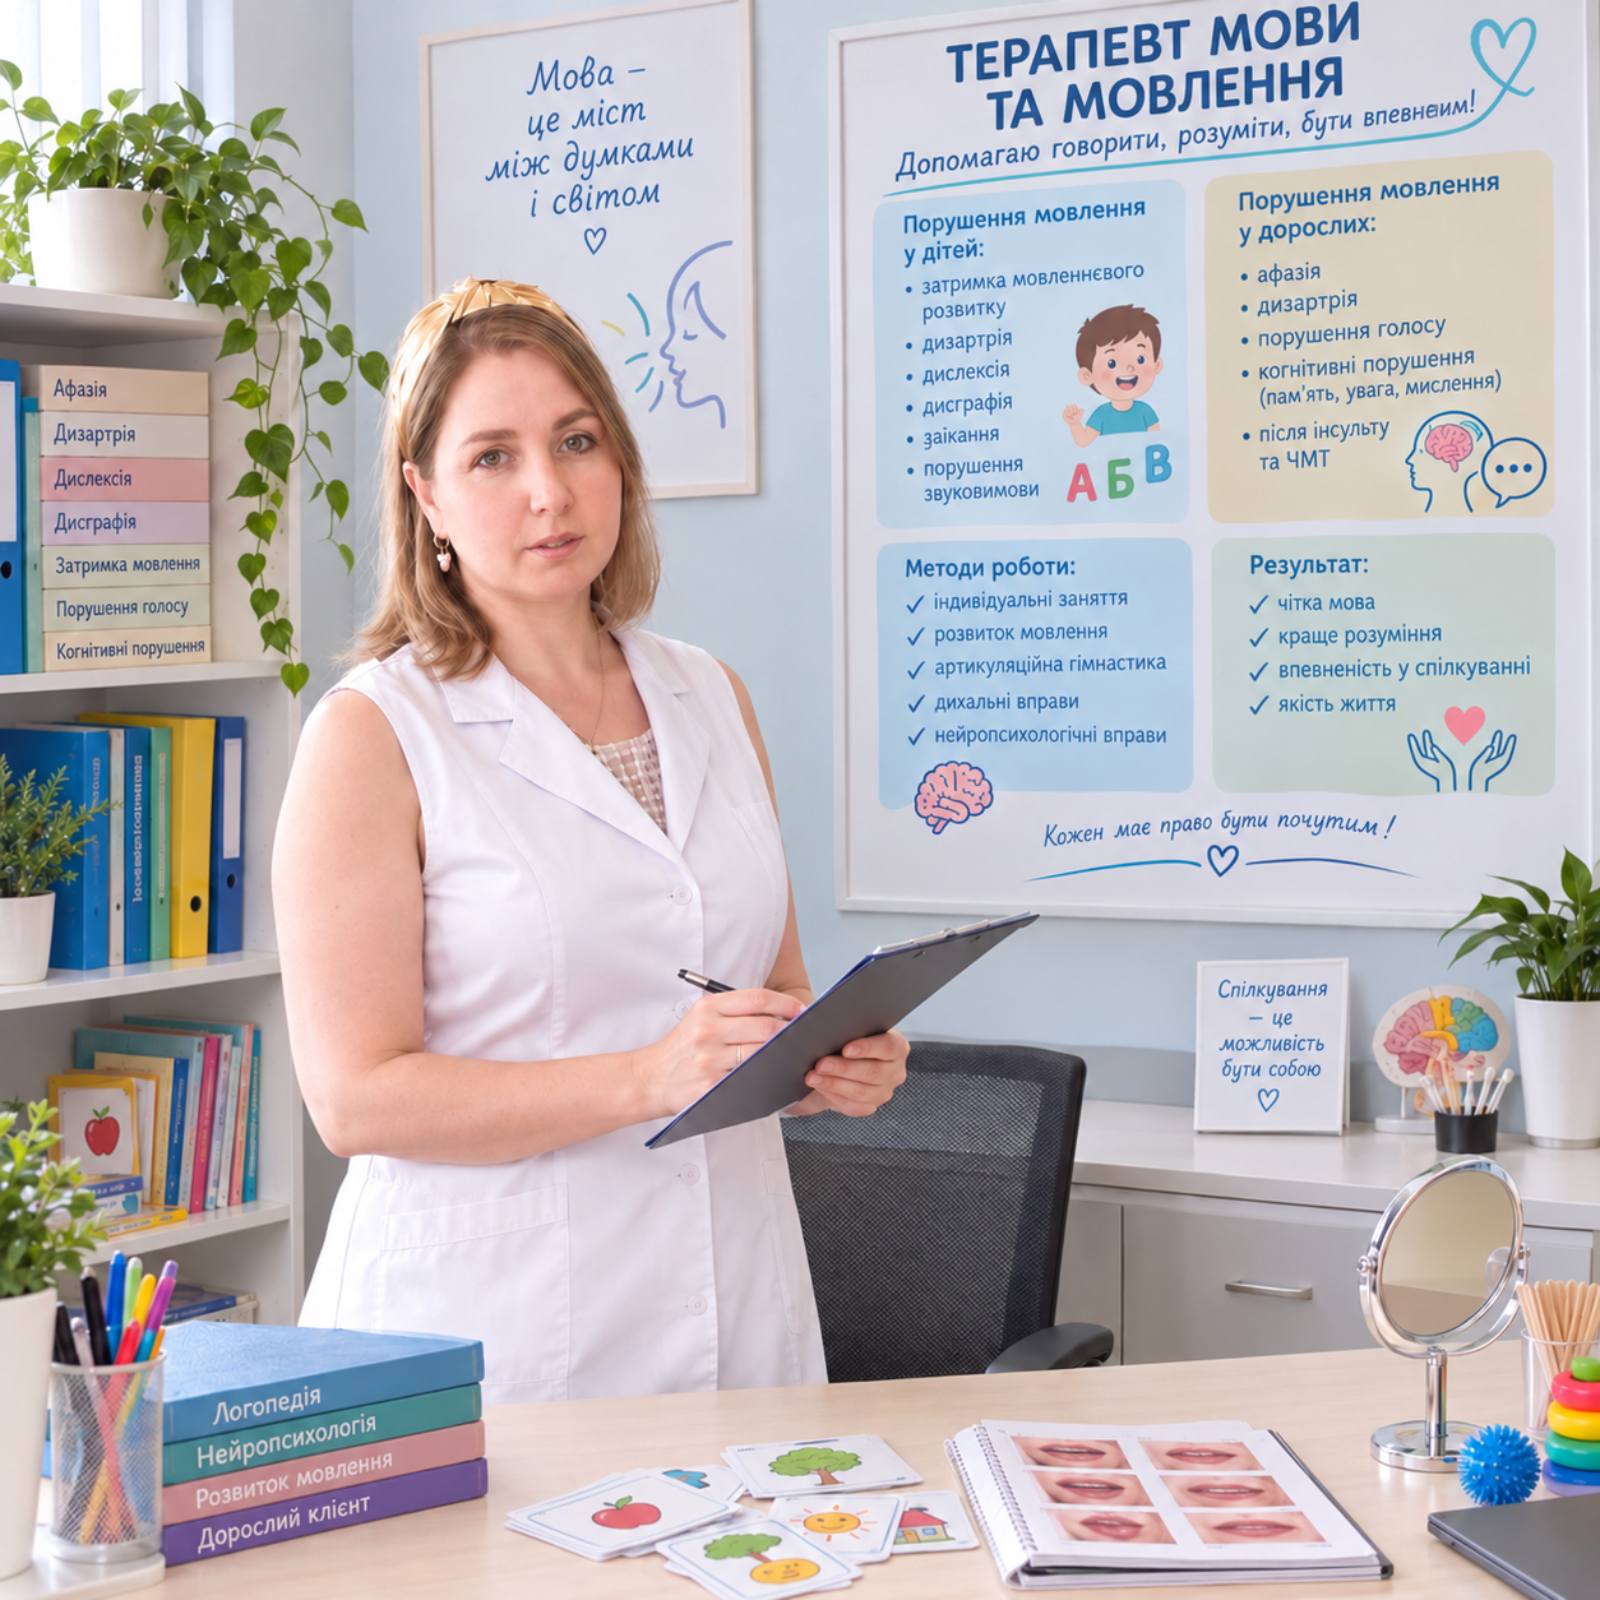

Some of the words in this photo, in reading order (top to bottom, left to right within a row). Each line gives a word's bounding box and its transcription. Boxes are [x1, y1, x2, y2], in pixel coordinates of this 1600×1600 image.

[947, 19, 1190, 82] ТЕРАПЕВТ
[1210, 2, 1359, 56] МОВИ
[527, 56, 614, 95] Мова
[987, 88, 1043, 130] ТА
[1063, 56, 1343, 123] МОВЛЕННЯ
[528, 112, 560, 141] це
[571, 99, 646, 129] міст
[895, 144, 1040, 182] Допомагаю
[1052, 132, 1166, 160] говорити,
[1179, 117, 1291, 154] розуміти,
[1301, 110, 1353, 140] бути
[485, 151, 550, 181] між
[563, 138, 694, 180] думками
[531, 190, 538, 217] і
[553, 184, 660, 215] світом
[1239, 186, 1372, 214] Порушення
[1380, 176, 1500, 200] мовлення
[904, 210, 1026, 236] Порушення
[1034, 201, 1145, 225] мовлення
[1239, 227, 1251, 247] у
[1258, 216, 1376, 244] дорослих:
[905, 248, 916, 267] у
[922, 240, 984, 264] дітей:
[922, 274, 1006, 296] затримка
[1012, 264, 1145, 287] мовленнєвого
[1257, 262, 1321, 287] афазія
[922, 301, 1006, 324] розвитку
[1257, 289, 1358, 317] дизартрія
[922, 329, 1013, 354] дизартрія
[1259, 325, 1370, 350] порушення
[1378, 318, 1446, 338] голосу
[922, 360, 1010, 386] дислексія
[1259, 356, 1356, 380] когнітивні
[1363, 350, 1475, 376] порушення
[54, 378, 107, 402] Афазія
[1346, 383, 1400, 404] увага,
[1405, 369, 1501, 397] мислення)
[922, 393, 1013, 417] дисграфія
[54, 423, 135, 446] Дизартрія
[1259, 424, 1307, 442] після
[1313, 420, 1390, 440] інсульту
[924, 458, 1024, 479] порушення
[1259, 457, 1279, 470] та
[1286, 450, 1330, 468] ЧМТ
[54, 469, 132, 490] Дислексія
[1067, 463, 1097, 502] А
[1107, 458, 1134, 499] Б
[1145, 444, 1172, 483] В
[924, 482, 1039, 505] звуковимови
[54, 512, 136, 535] Дисграфія
[56, 557, 127, 578] Затримка
[132, 558, 200, 572] мовлення
[905, 559, 984, 580] Методи
[992, 556, 1076, 581] роботи:
[1250, 555, 1369, 579] Результат:
[57, 600, 138, 621] Порушення
[143, 600, 189, 618] голосу
[934, 590, 1052, 612] індивідуальні
[1058, 591, 1128, 606] заняття
[1278, 593, 1322, 611] чітка
[1329, 596, 1376, 610] мова
[935, 626, 1014, 646] розвиток
[1020, 625, 1108, 641] мовлення
[1279, 629, 1338, 648] краще
[1345, 624, 1442, 648] розуміння
[57, 642, 128, 660] Когнітивні
[132, 640, 205, 659] порушення
[935, 656, 1063, 679] артикуляційна
[1069, 654, 1167, 672] гімнастика
[1279, 659, 1391, 679] впевненість
[1399, 662, 1409, 682] у
[1415, 656, 1531, 681] спілкуванні
[935, 692, 1011, 713] дихальні
[1017, 695, 1079, 714] вправи
[1279, 694, 1334, 713] якість
[1340, 696, 1396, 712] життя
[935, 725, 1097, 747] нейропсихологічні
[1104, 728, 1167, 747] вправи
[1044, 823, 1104, 847] Кожен
[1160, 814, 1213, 840] право
[1221, 810, 1268, 836] бути
[1277, 813, 1378, 837] почутим
[1218, 979, 1328, 1004] Спілкування
[1272, 1012, 1293, 1028] це
[1219, 1034, 1324, 1051] можливість
[1222, 1058, 1261, 1083] бути
[1269, 1058, 1321, 1077] собою
[213, 1386, 321, 1426] Логопедія
[197, 1413, 376, 1469] Нейропсихологія
[197, 1473, 289, 1509] Розвиток
[296, 1452, 392, 1487] мовлення
[198, 1508, 300, 1553] Дорослий
[308, 1496, 370, 1524] клієнт
